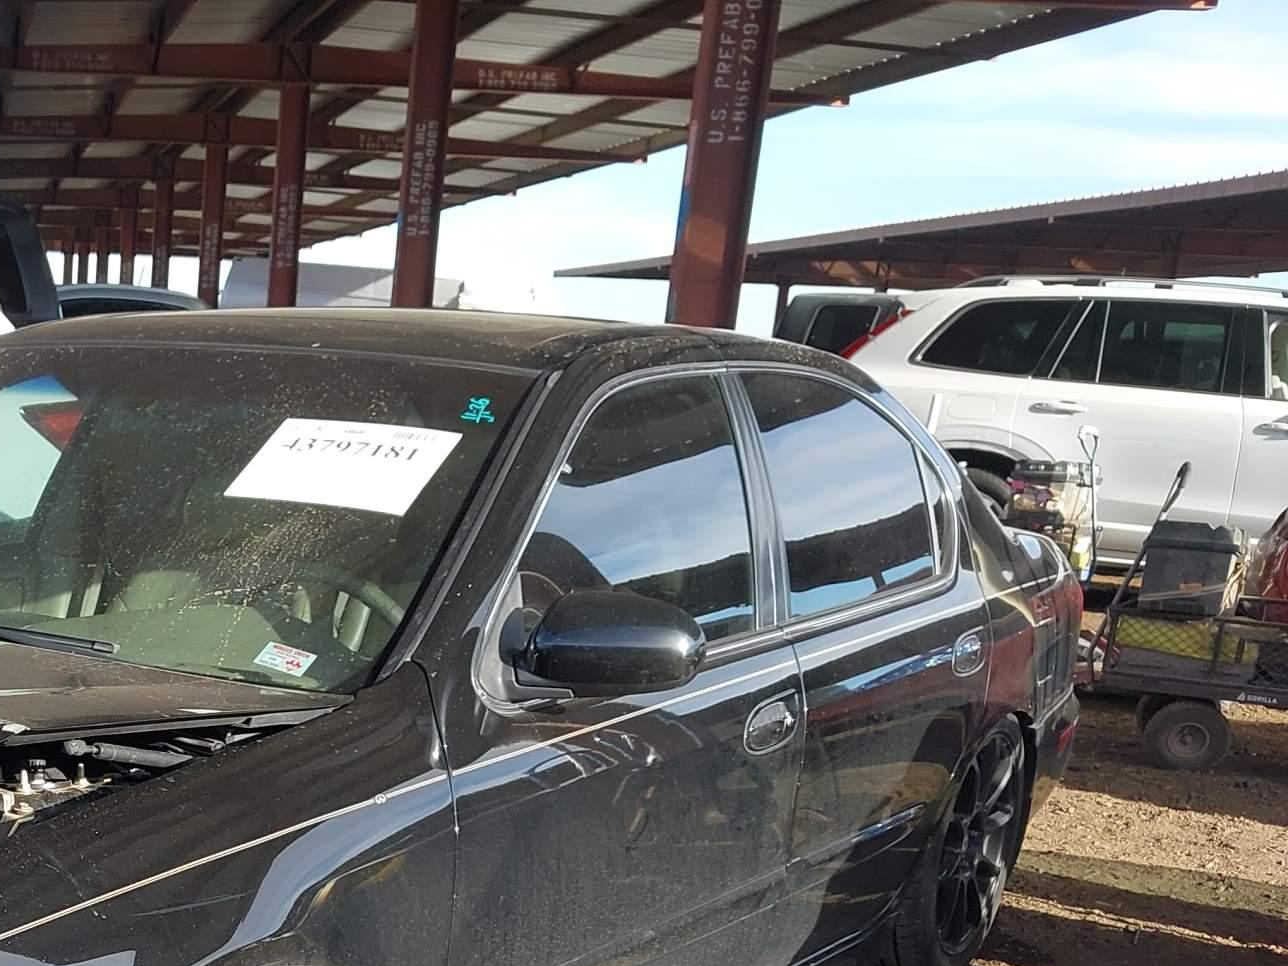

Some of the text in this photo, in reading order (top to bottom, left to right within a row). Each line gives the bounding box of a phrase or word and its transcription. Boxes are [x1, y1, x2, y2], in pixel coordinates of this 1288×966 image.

[707, 2, 741, 143] U.S. PREFAB
[1246, 694, 1278, 704] GORILLA
